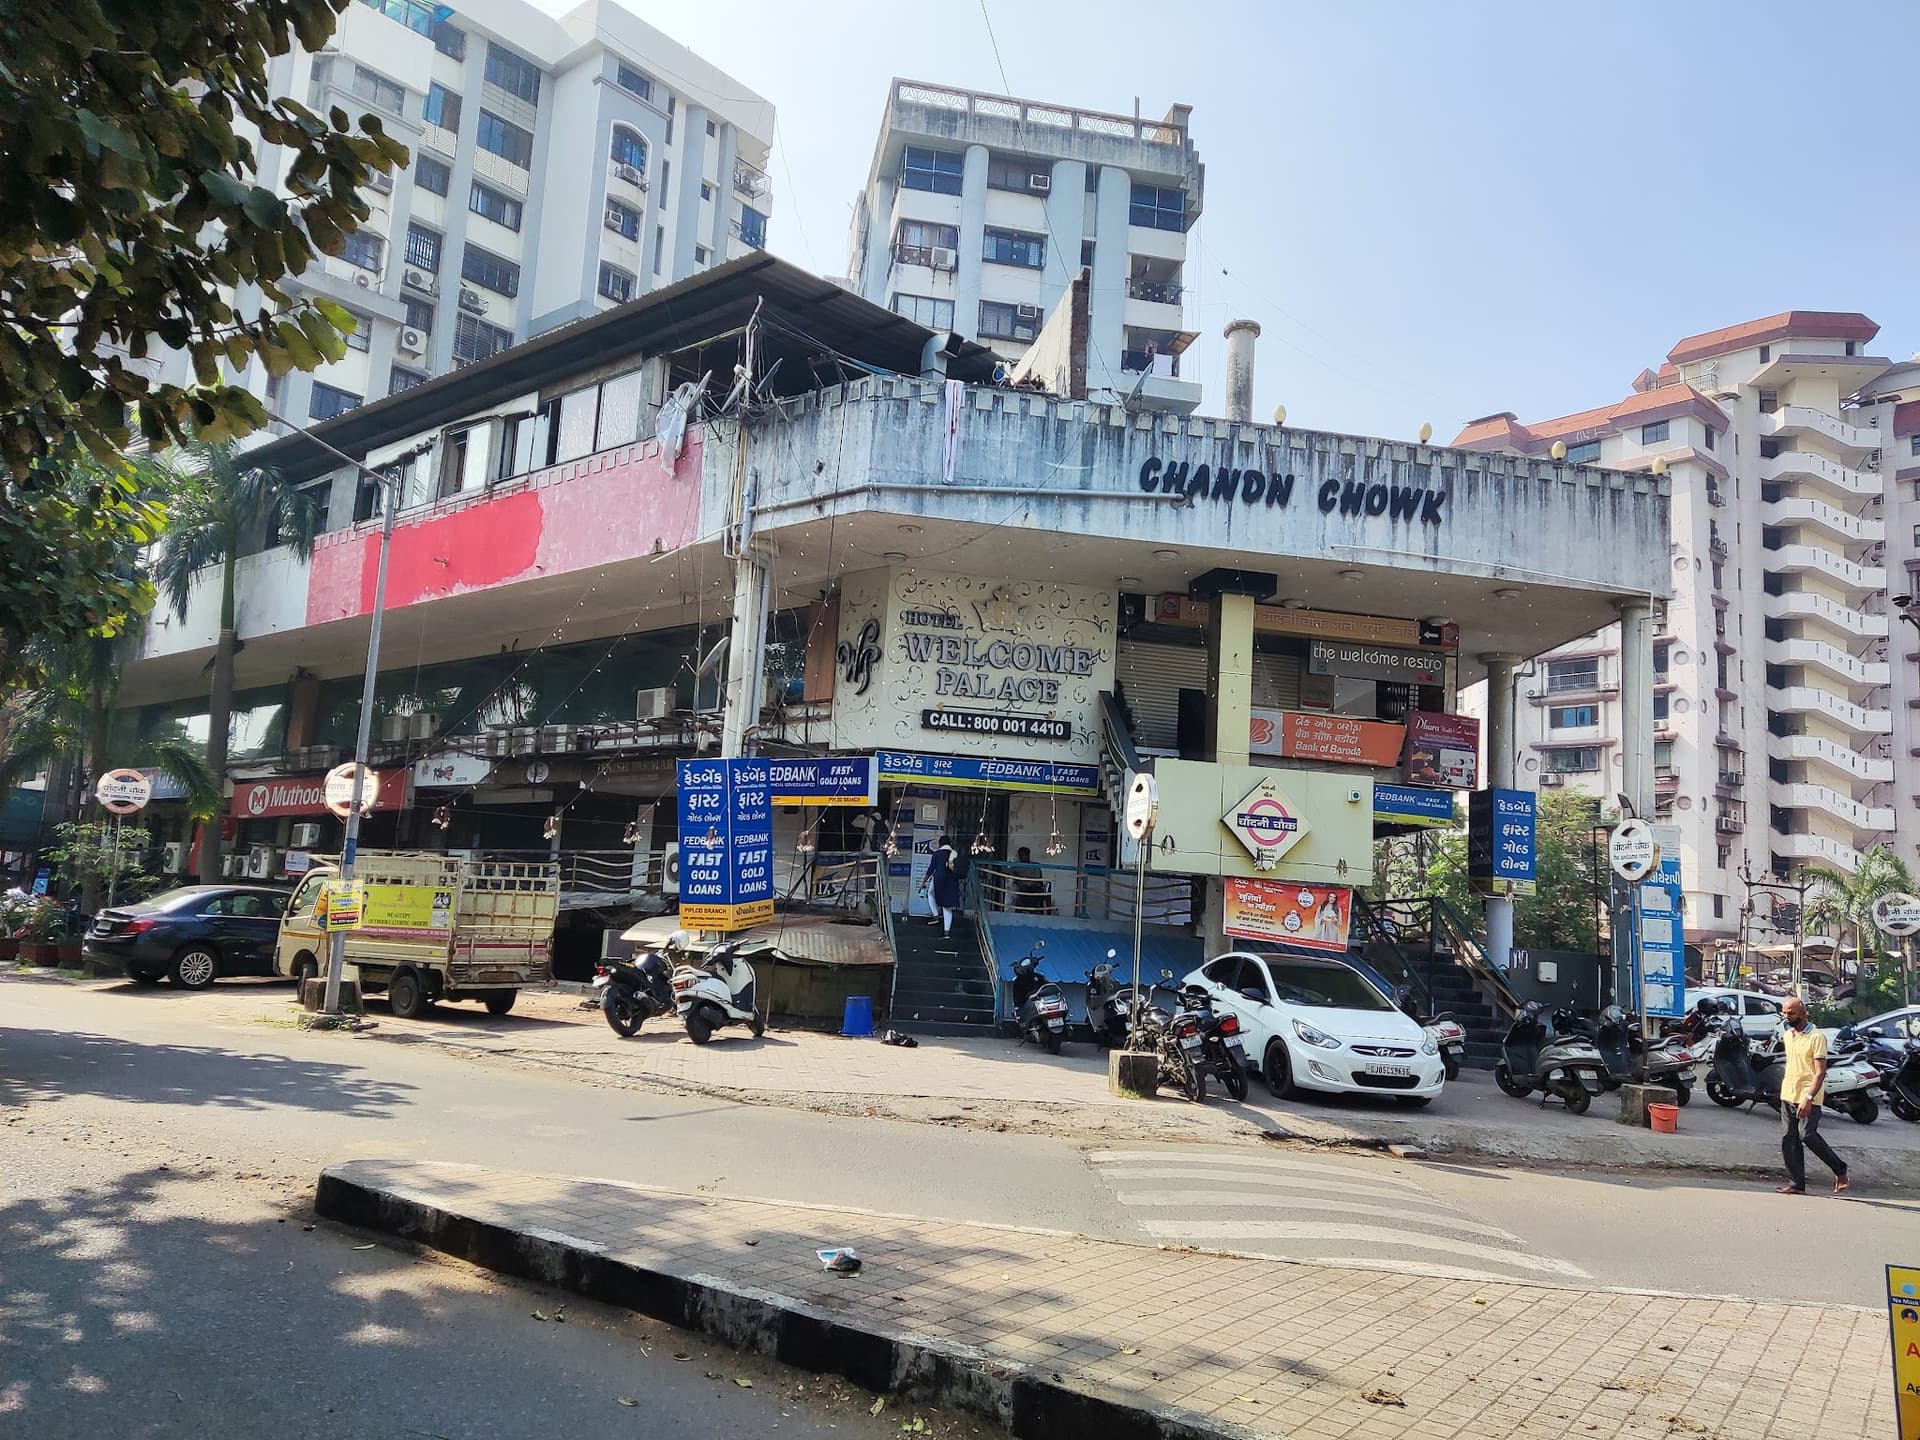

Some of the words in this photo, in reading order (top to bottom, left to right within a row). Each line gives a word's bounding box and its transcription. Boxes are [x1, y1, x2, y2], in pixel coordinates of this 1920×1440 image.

[1139, 457, 1295, 505] CHANDN
[1318, 479, 1446, 525] CHOWK
[905, 611, 963, 629] HOTEL
[904, 632, 1093, 675] WELCOME
[1313, 642, 1336, 659] the
[1340, 650, 1399, 666] welcome
[1403, 656, 1442, 671] restro
[936, 667, 1059, 702] PALACE
[1002, 716, 1027, 733] 001
[1030, 720, 1064, 736] 4410
[1295, 741, 1318, 752] Bank
[1320, 744, 1329, 752] of
[1330, 745, 1361, 756] Baroda
[769, 766, 816, 781] EDBANK
[831, 766, 851, 775] FAST
[979, 762, 1042, 777] FEDBANK
[1057, 768, 1080, 776] FAST
[820, 777, 837, 785] GOLD
[839, 776, 862, 785] LOANS
[1066, 776, 1089, 784] LOANS
[1375, 791, 1416, 803] FEDBANK
[683, 836, 725, 845] FEDBNK
[735, 833, 768, 846] FEDBANK
[687, 853, 723, 866] FAST
[738, 850, 767, 865] FAST
[691, 870, 719, 880] GOLD
[741, 867, 764, 879] GOLD
[688, 884, 722, 895] LOANS
[739, 881, 767, 895] LOANS
